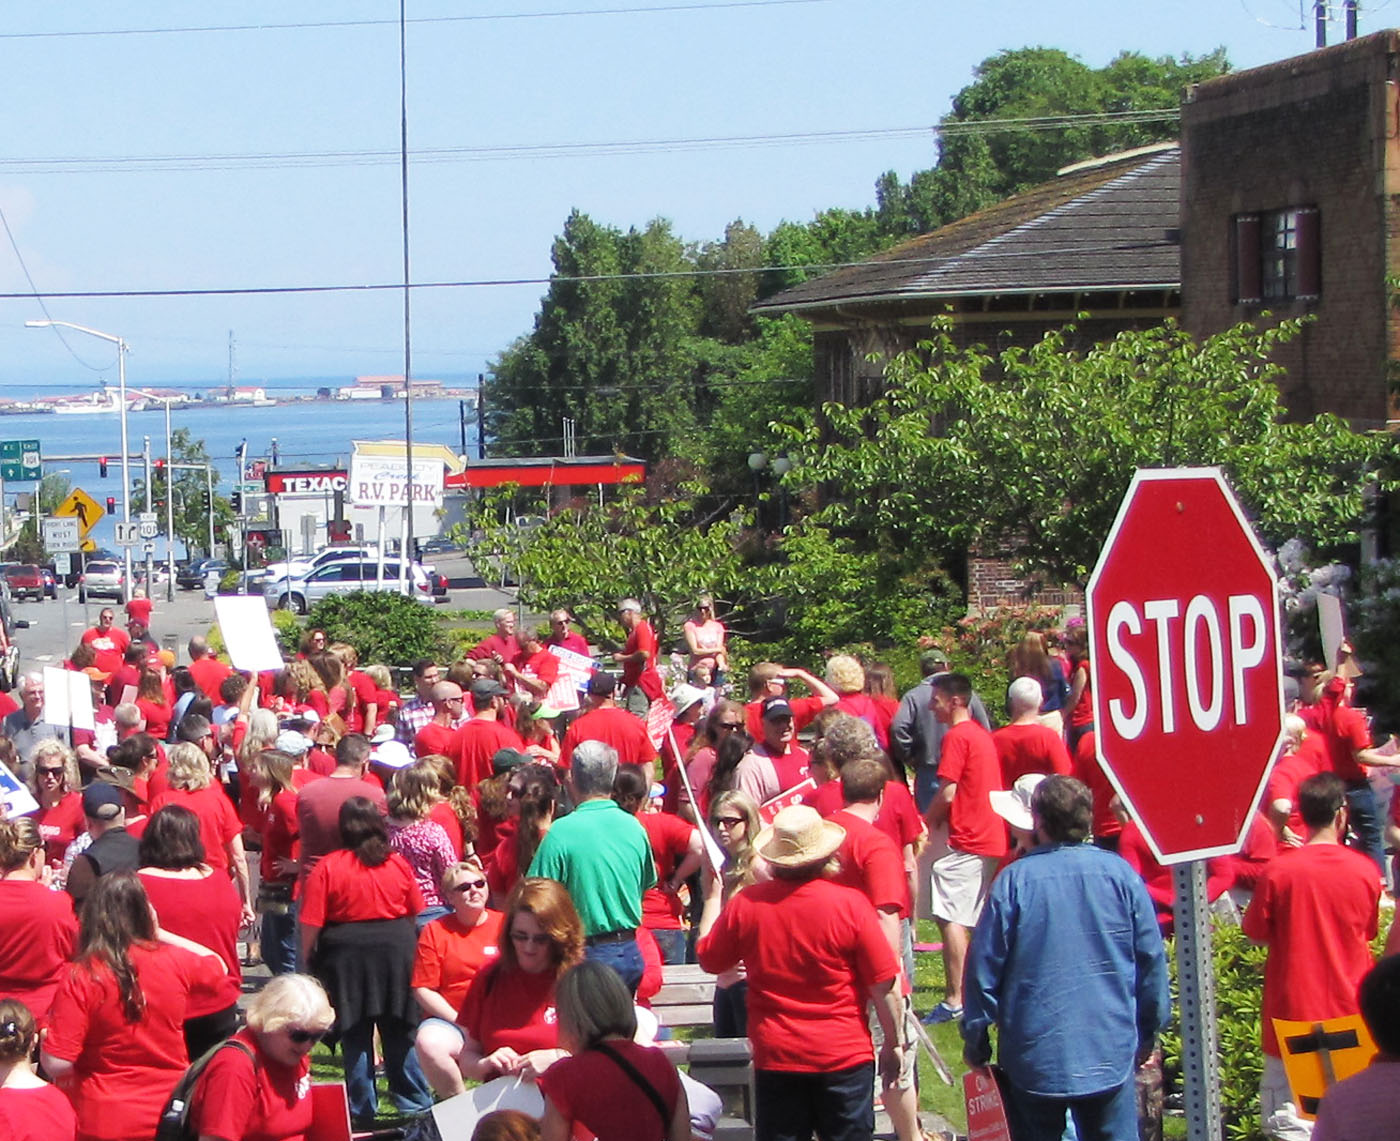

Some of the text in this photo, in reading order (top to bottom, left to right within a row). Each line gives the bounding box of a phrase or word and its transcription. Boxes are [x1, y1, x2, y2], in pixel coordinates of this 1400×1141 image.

[358, 481, 437, 502] R.V. PARK
[1106, 594, 1267, 741] STOP
[968, 1090, 1000, 1116] STRIKE
